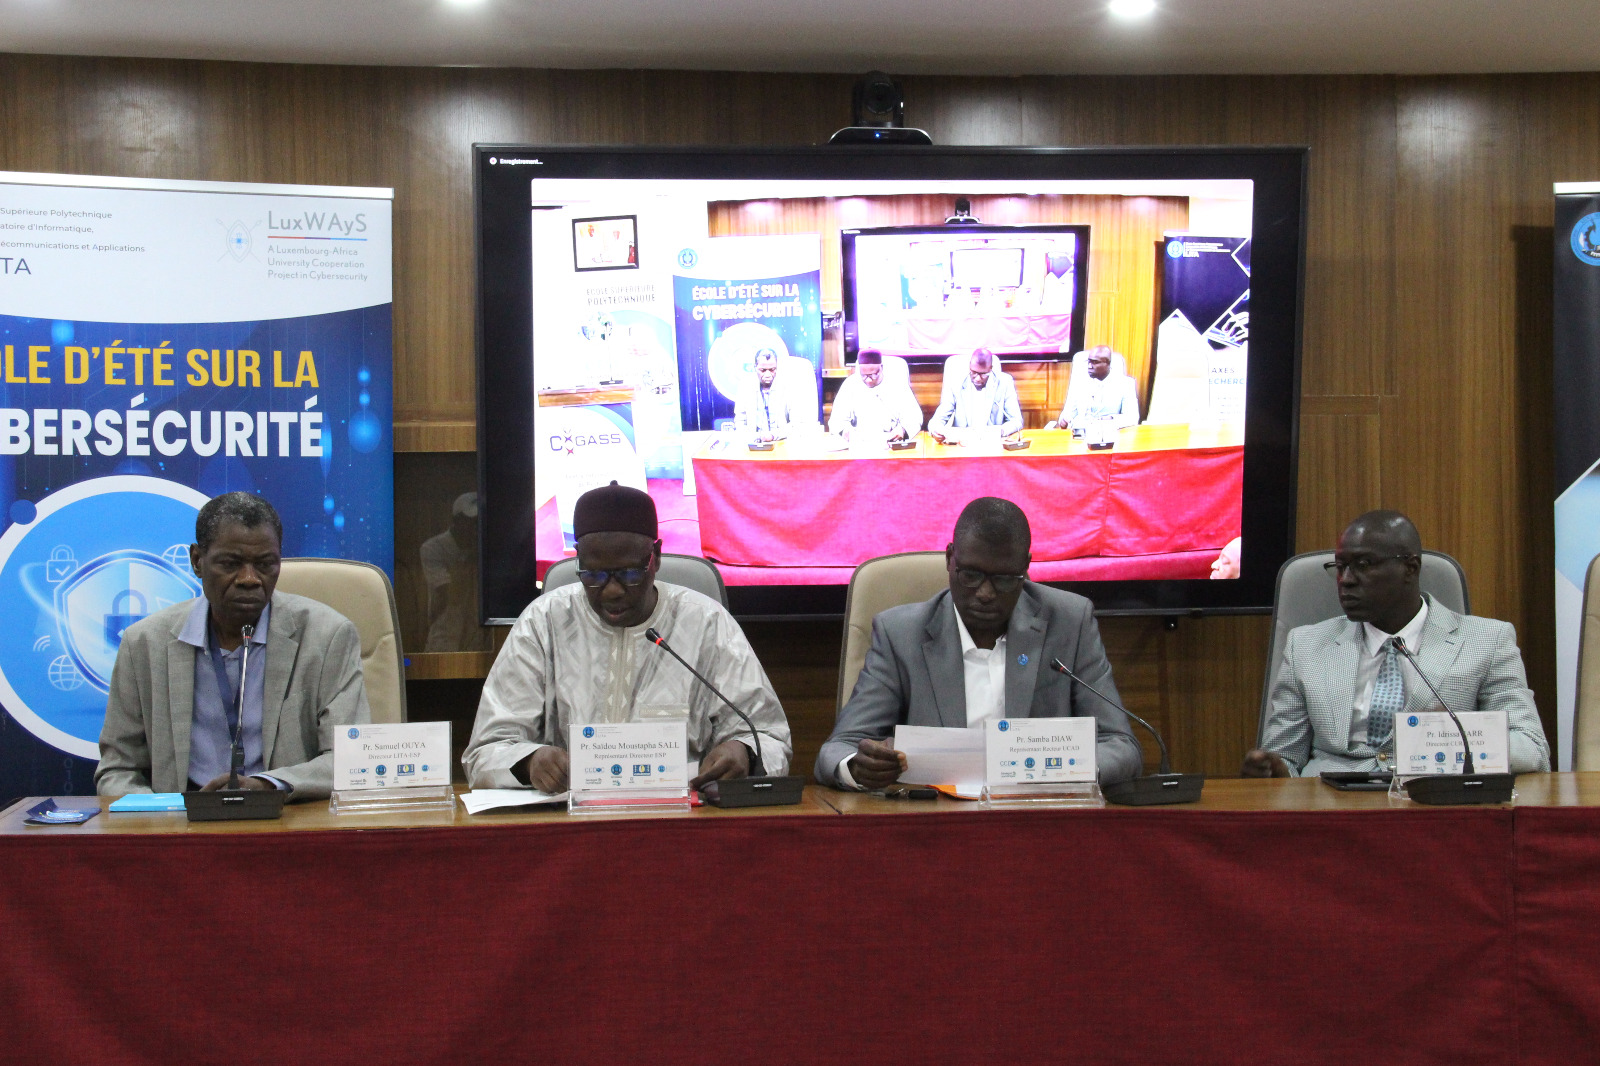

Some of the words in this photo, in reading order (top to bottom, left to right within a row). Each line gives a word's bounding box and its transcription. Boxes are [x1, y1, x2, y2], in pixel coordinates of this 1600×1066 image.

[0, 207, 48, 217] Supérieure
[50, 209, 113, 219] Polytechnique
[27, 224, 95, 234] d'Informatique,
[267, 210, 368, 236] LuxWAyS
[0, 240, 80, 250] écommunications
[81, 243, 90, 251] et
[92, 243, 146, 253] Applications
[267, 244, 275, 254] A
[0, 257, 32, 275] TA
[267, 257, 311, 269] University
[311, 258, 365, 269] Cooperation
[267, 269, 299, 281] Project
[299, 271, 308, 280] in
[309, 270, 368, 282] Cybersecurity
[692, 285, 727, 301] ÉCOLE
[728, 282, 760, 299] D'ÉTÉ
[761, 283, 784, 298] SUR
[785, 283, 800, 297] LA
[692, 297, 804, 321] CYBERSÉCURITÉ
[0, 344, 52, 384] LE
[64, 339, 175, 387] D'ÉTÉ
[186, 347, 262, 389] SUR
[273, 349, 320, 389] LA
[0, 392, 324, 458] BERSÉCURITÉ
[1016, 736, 1026, 744] Pr.
[1027, 735, 1050, 744] Samba
[1051, 735, 1073, 743] DIAW
[1438, 730, 1460, 738] Idrissa
[1464, 729, 1483, 738] ARR
[362, 743, 373, 751] Pr.
[374, 742, 400, 751] Samuel
[401, 741, 427, 750] OUYA
[580, 742, 591, 750] Pr.
[618, 741, 657, 751] Moustapha
[658, 741, 680, 749] SALL
